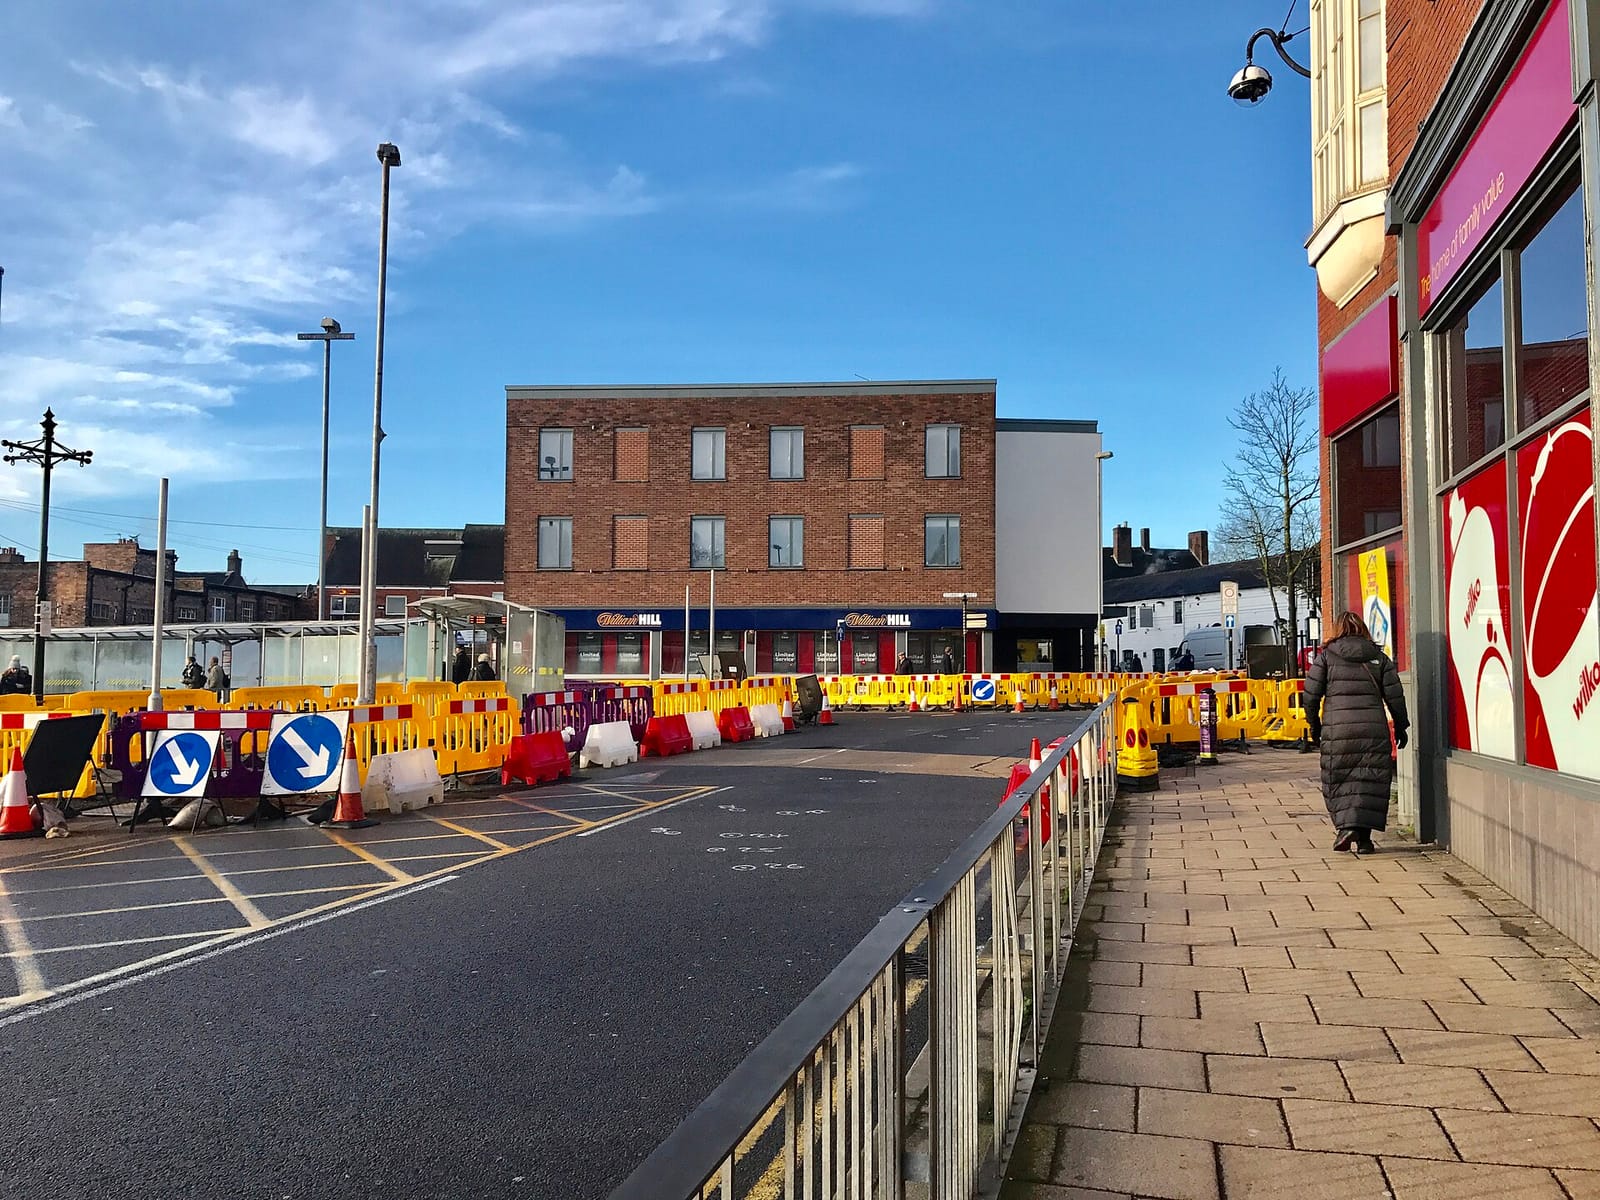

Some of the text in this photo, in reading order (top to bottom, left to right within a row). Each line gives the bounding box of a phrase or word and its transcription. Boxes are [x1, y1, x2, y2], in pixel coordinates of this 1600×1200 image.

[1431, 248, 1450, 282] home
[1451, 230, 1458, 258] of
[1459, 202, 1480, 249] family
[1481, 172, 1505, 215] value
[597, 612, 661, 627] William HILL
[845, 613, 911, 627] William HILL
[1464, 578, 1481, 630] wilko
[1573, 661, 1600, 721] wilko
